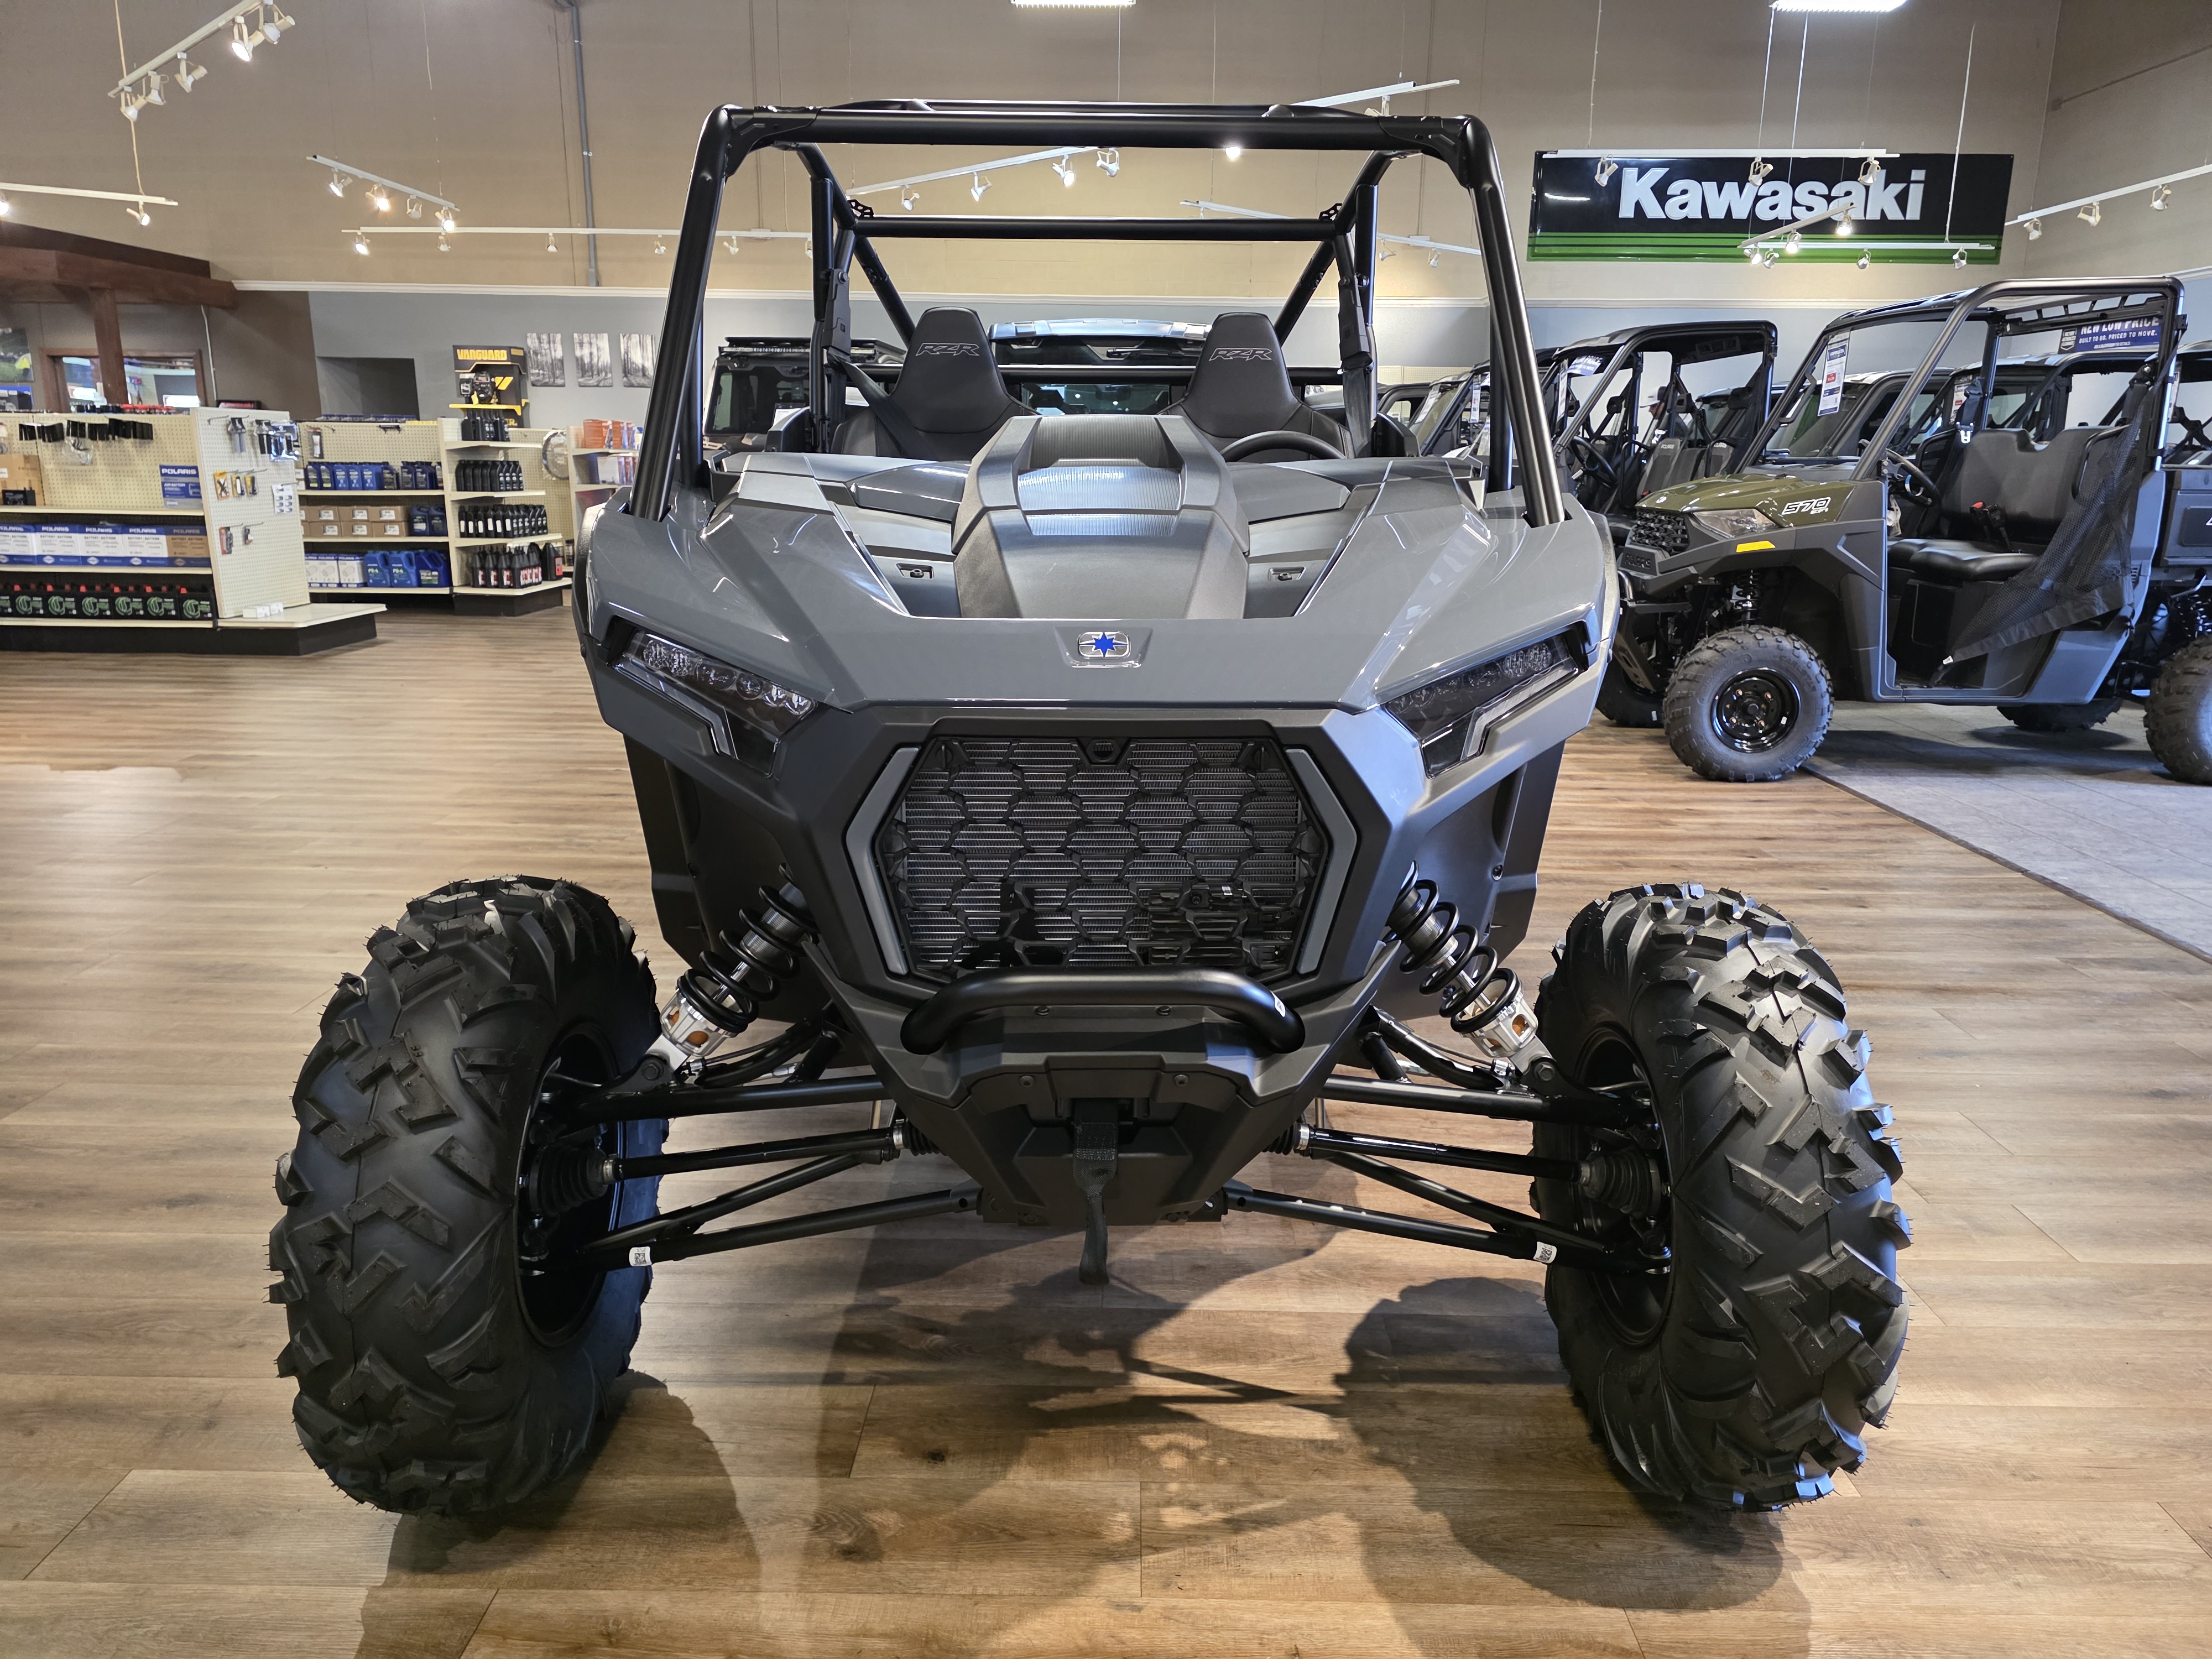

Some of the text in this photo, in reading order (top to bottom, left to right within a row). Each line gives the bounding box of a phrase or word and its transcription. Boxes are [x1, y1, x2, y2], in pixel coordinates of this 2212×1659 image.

[1619, 167, 1926, 220] Kawasaki
[457, 349, 507, 360] VANGUARD
[915, 343, 979, 356] RZR
[1208, 348, 1272, 361] RZR
[1781, 497, 1831, 515] 570
